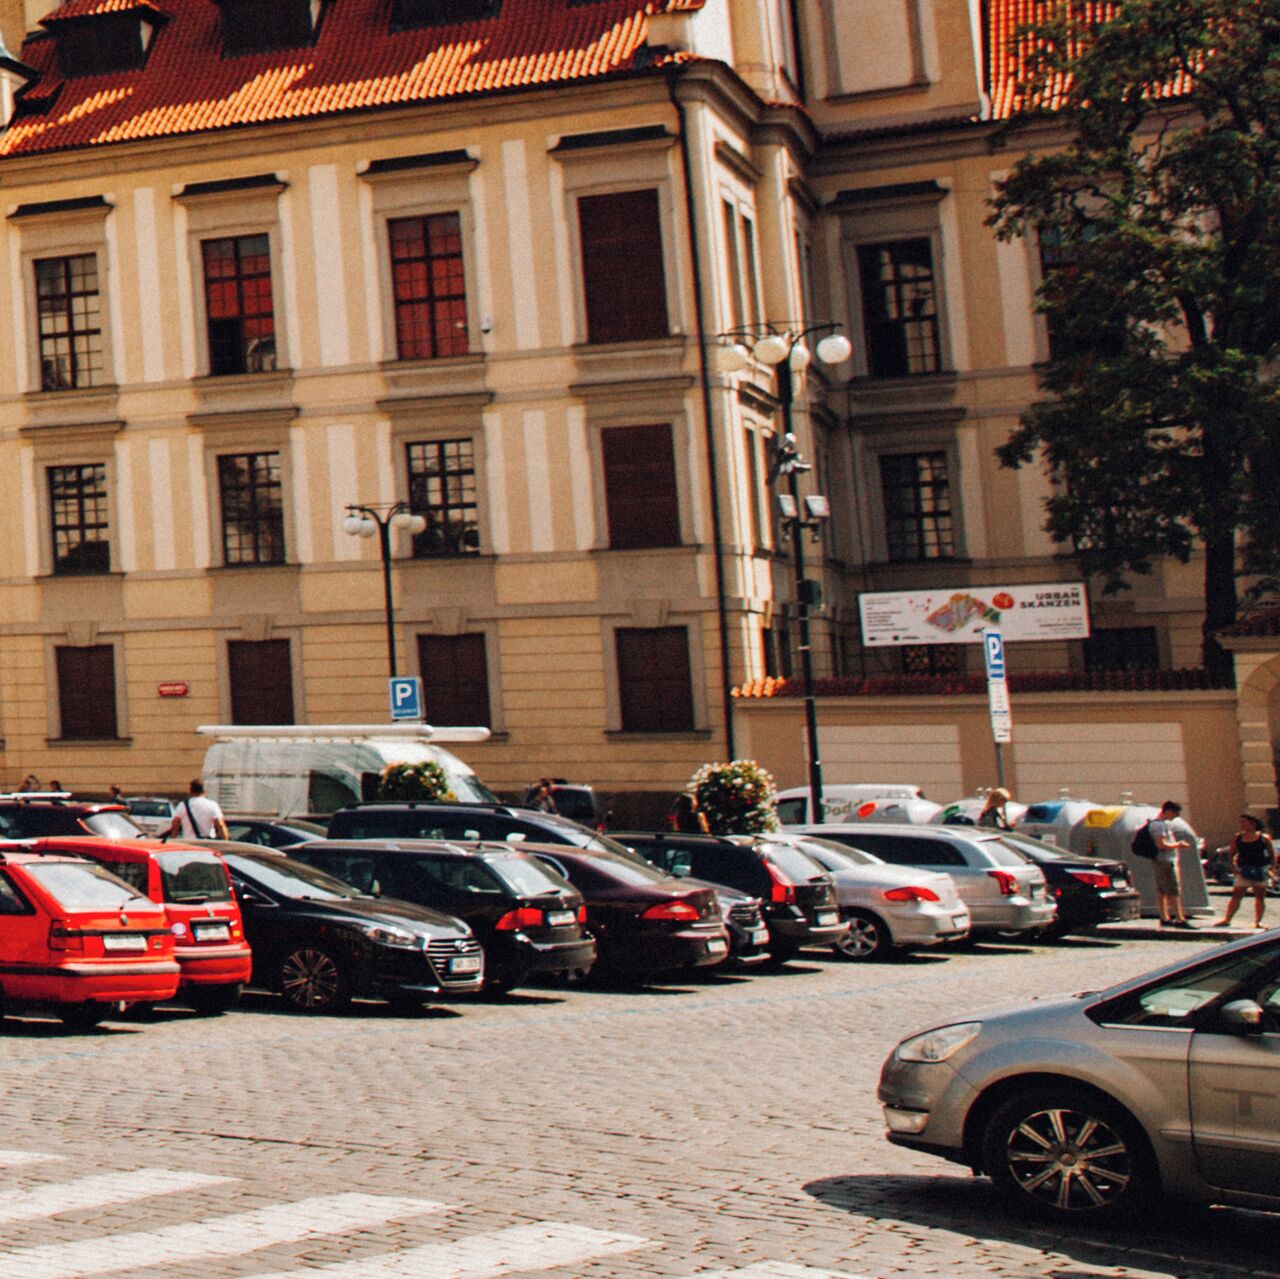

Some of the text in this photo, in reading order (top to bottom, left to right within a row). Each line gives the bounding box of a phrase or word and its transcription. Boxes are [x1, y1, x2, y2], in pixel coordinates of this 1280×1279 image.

[1035, 591, 1080, 601] URBAN
[1020, 600, 1081, 609] SKANZEN
[988, 637, 1001, 665] P
[396, 683, 412, 706] P
